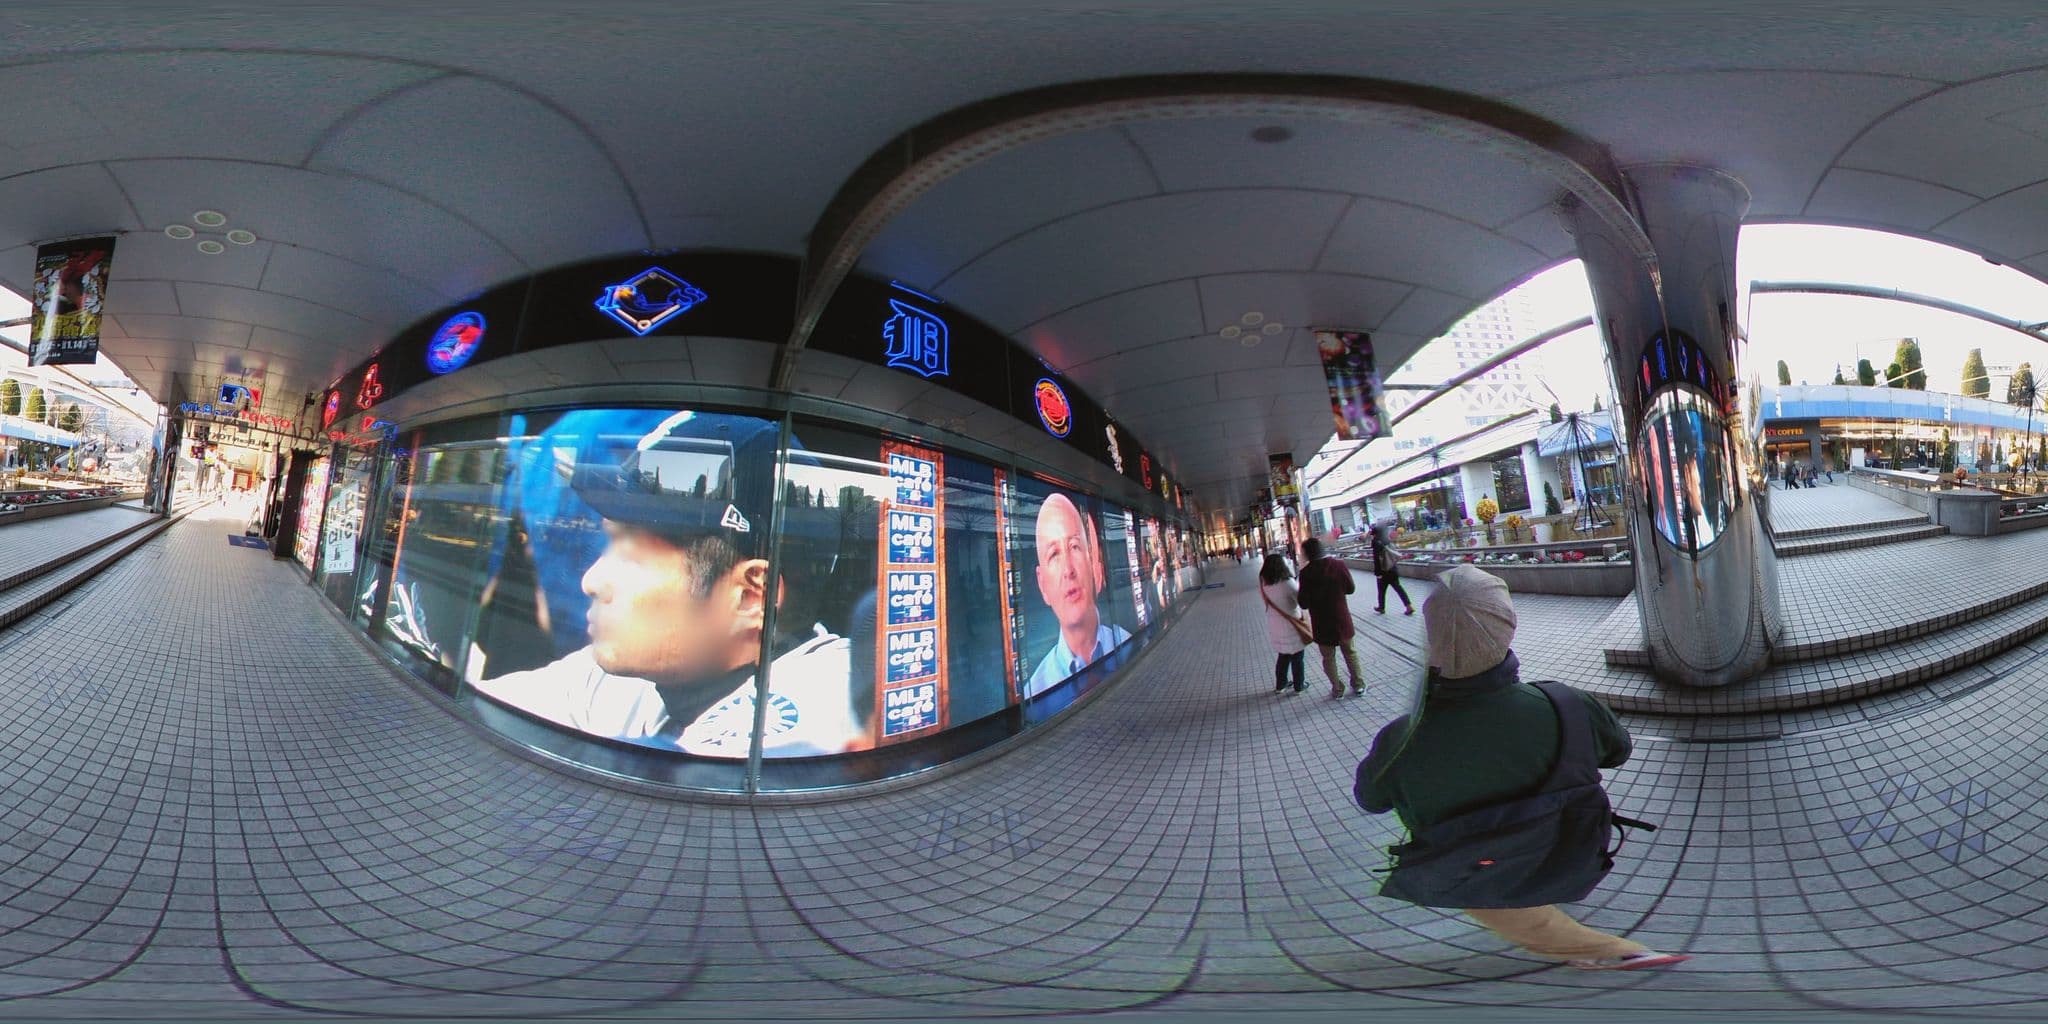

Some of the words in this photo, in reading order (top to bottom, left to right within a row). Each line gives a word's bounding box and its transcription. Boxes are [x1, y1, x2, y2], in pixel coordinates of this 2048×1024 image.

[239, 409, 292, 429] TOKYO
[1777, 427, 1804, 436] COFFEE
[892, 457, 933, 479] MLB
[891, 513, 933, 533] MLB
[890, 574, 933, 592] MLB
[889, 631, 934, 652] MLB
[888, 685, 934, 708] MLB
